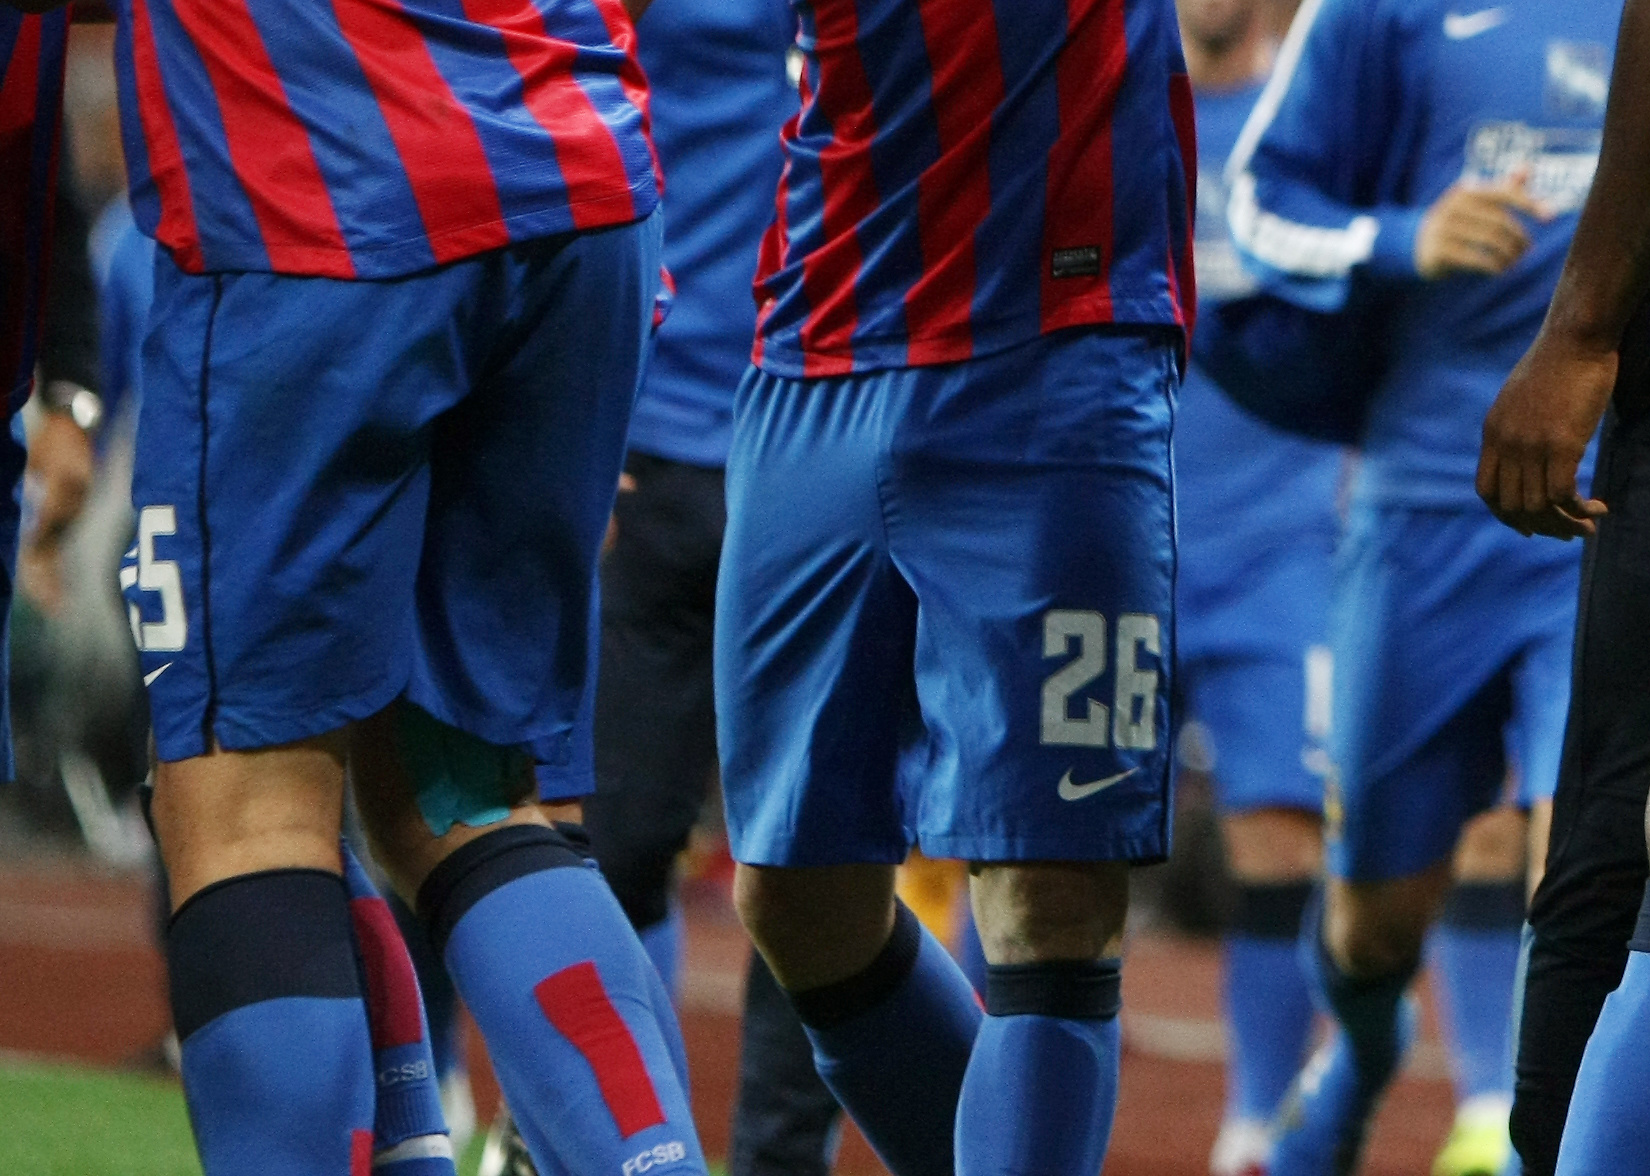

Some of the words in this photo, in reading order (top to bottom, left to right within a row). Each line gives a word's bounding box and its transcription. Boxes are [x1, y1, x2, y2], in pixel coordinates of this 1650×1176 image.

[1039, 609, 1161, 751] 26
[379, 1060, 429, 1084] CSB
[621, 1140, 687, 1176] FCSB
